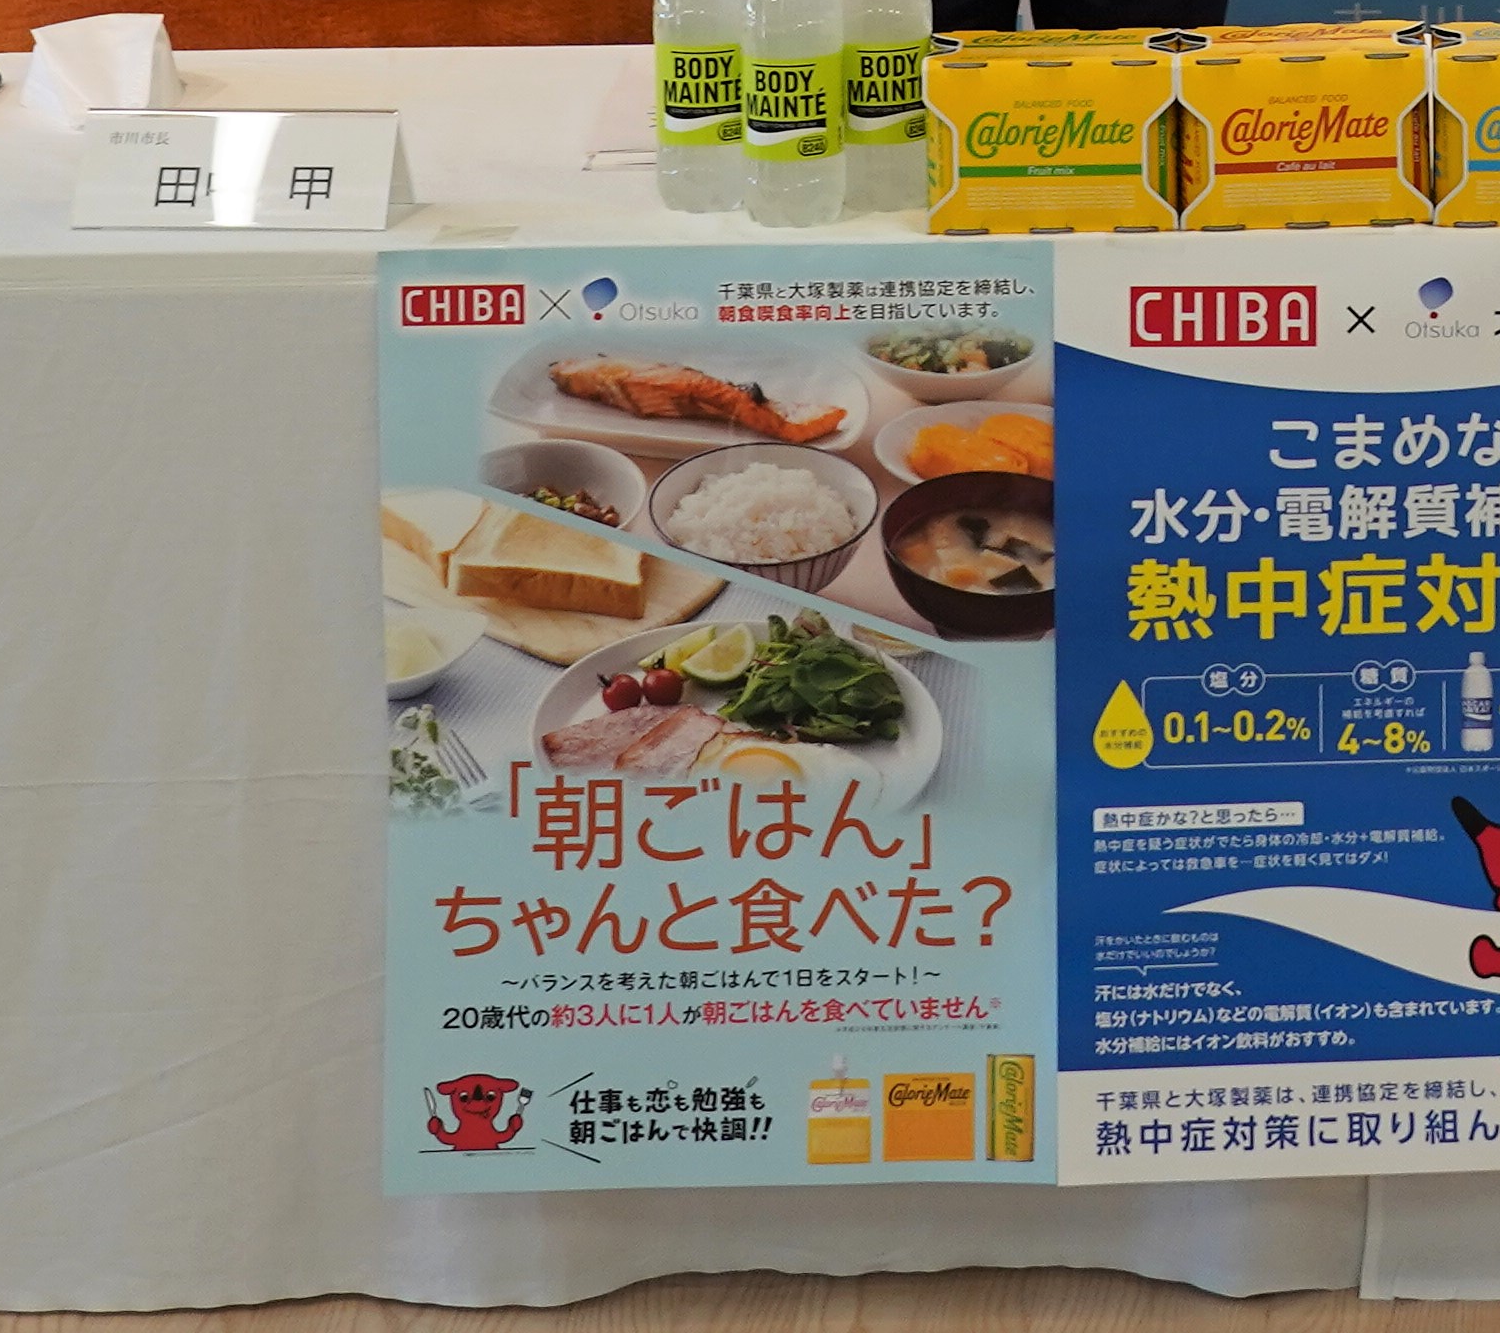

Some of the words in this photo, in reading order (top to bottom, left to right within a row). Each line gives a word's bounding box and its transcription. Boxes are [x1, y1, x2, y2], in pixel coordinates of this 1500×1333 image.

[675, 55, 733, 79] BODY
[861, 53, 918, 78] BODY
[756, 70, 815, 93] BODY
[847, 76, 922, 102] MAINT
[747, 88, 826, 117] MAINTÉ
[1013, 99, 1062, 109] BALANCED
[1067, 99, 1094, 108] FOOD
[1268, 95, 1317, 105] BALANCED
[1322, 94, 1349, 103] FOOD
[109, 132, 170, 146] 市川市長
[965, 111, 1135, 159] CalorieMate
[1221, 105, 1389, 156] CalorieMate
[289, 166, 333, 210] 甲
[717, 280, 1035, 300] 千葉県と大塚製薬は連携協定を締結し、
[404, 289, 521, 322] CHIBA
[619, 302, 699, 321] Otsuka
[717, 302, 999, 322] 朝食喫食率向上を目指しています。
[1135, 291, 1310, 342] CHIBA
[1405, 320, 1480, 339] Otsuka
[510, 762, 932, 870] 「朝ごはん」
[435, 874, 1013, 957] ちゃんと食べた?
[1094, 982, 1243, 1002] 汗には水だけでなく、
[1094, 1031, 1356, 1056] 水分補給にはイオン飲料がおすすめ。
[569, 1086, 766, 1114] 仕事も恋も勉強も
[1097, 1079, 1498, 1112] 千葉県と大塚製薬は、連携協定を締結し、
[569, 1117, 772, 1145] 朝ごはんで快調!!
